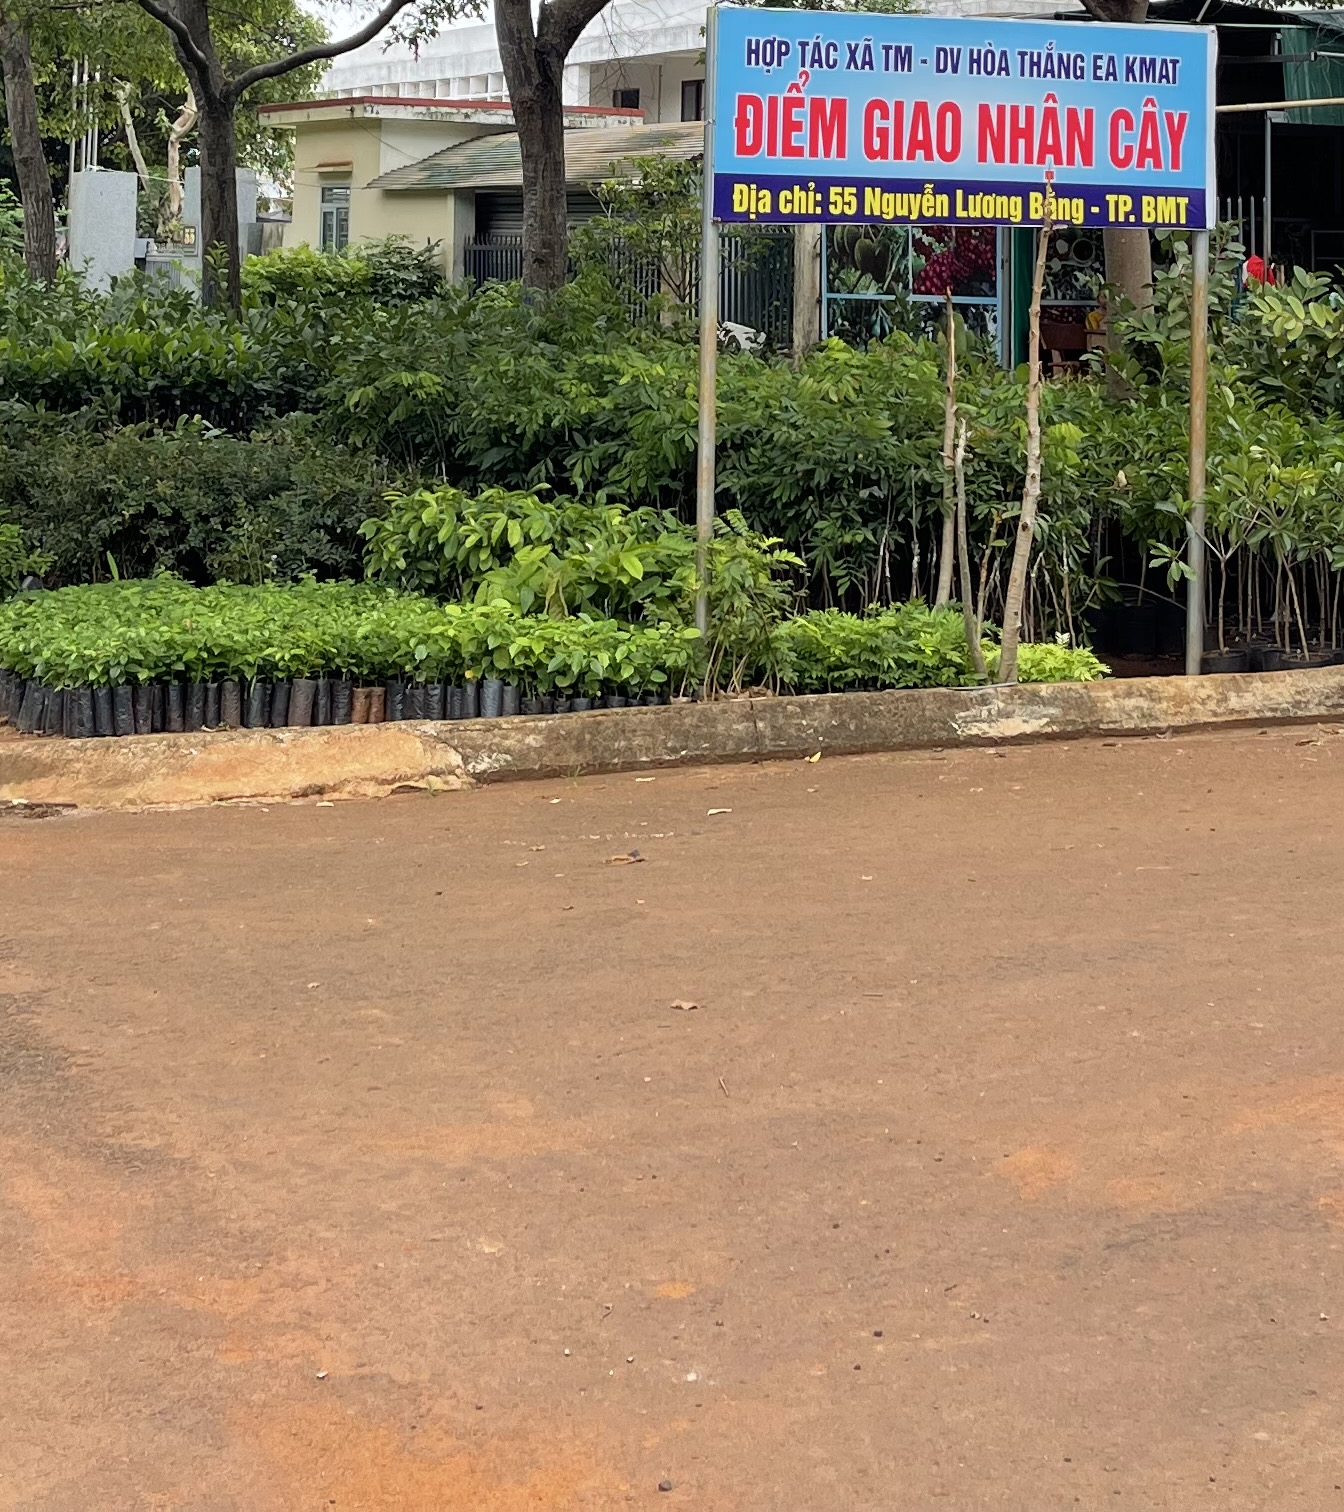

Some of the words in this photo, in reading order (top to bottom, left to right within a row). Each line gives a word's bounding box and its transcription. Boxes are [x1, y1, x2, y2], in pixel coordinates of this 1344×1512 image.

[747, 37, 790, 73] HỢP
[798, 36, 837, 69] TÁC
[846, 38, 873, 70] XÃ
[882, 45, 912, 72] TM
[936, 47, 961, 74] DV
[969, 43, 1010, 76] HÒA
[1018, 42, 1084, 80] THẮNG
[1093, 55, 1117, 81] EA
[1125, 56, 1179, 84] KMAT
[736, 71, 846, 158] ĐIỂM
[864, 99, 961, 162] GIAO
[978, 94, 1093, 180] NHẬN
[1110, 98, 1186, 170] CÂY
[733, 183, 771, 219] Địa
[779, 182, 822, 214] chỉ:
[830, 188, 856, 214] 55
[865, 185, 948, 219] Nguyễn
[957, 191, 1021, 222] Lương
[1106, 194, 1135, 223] TP.
[1142, 196, 1188, 224] BMT
